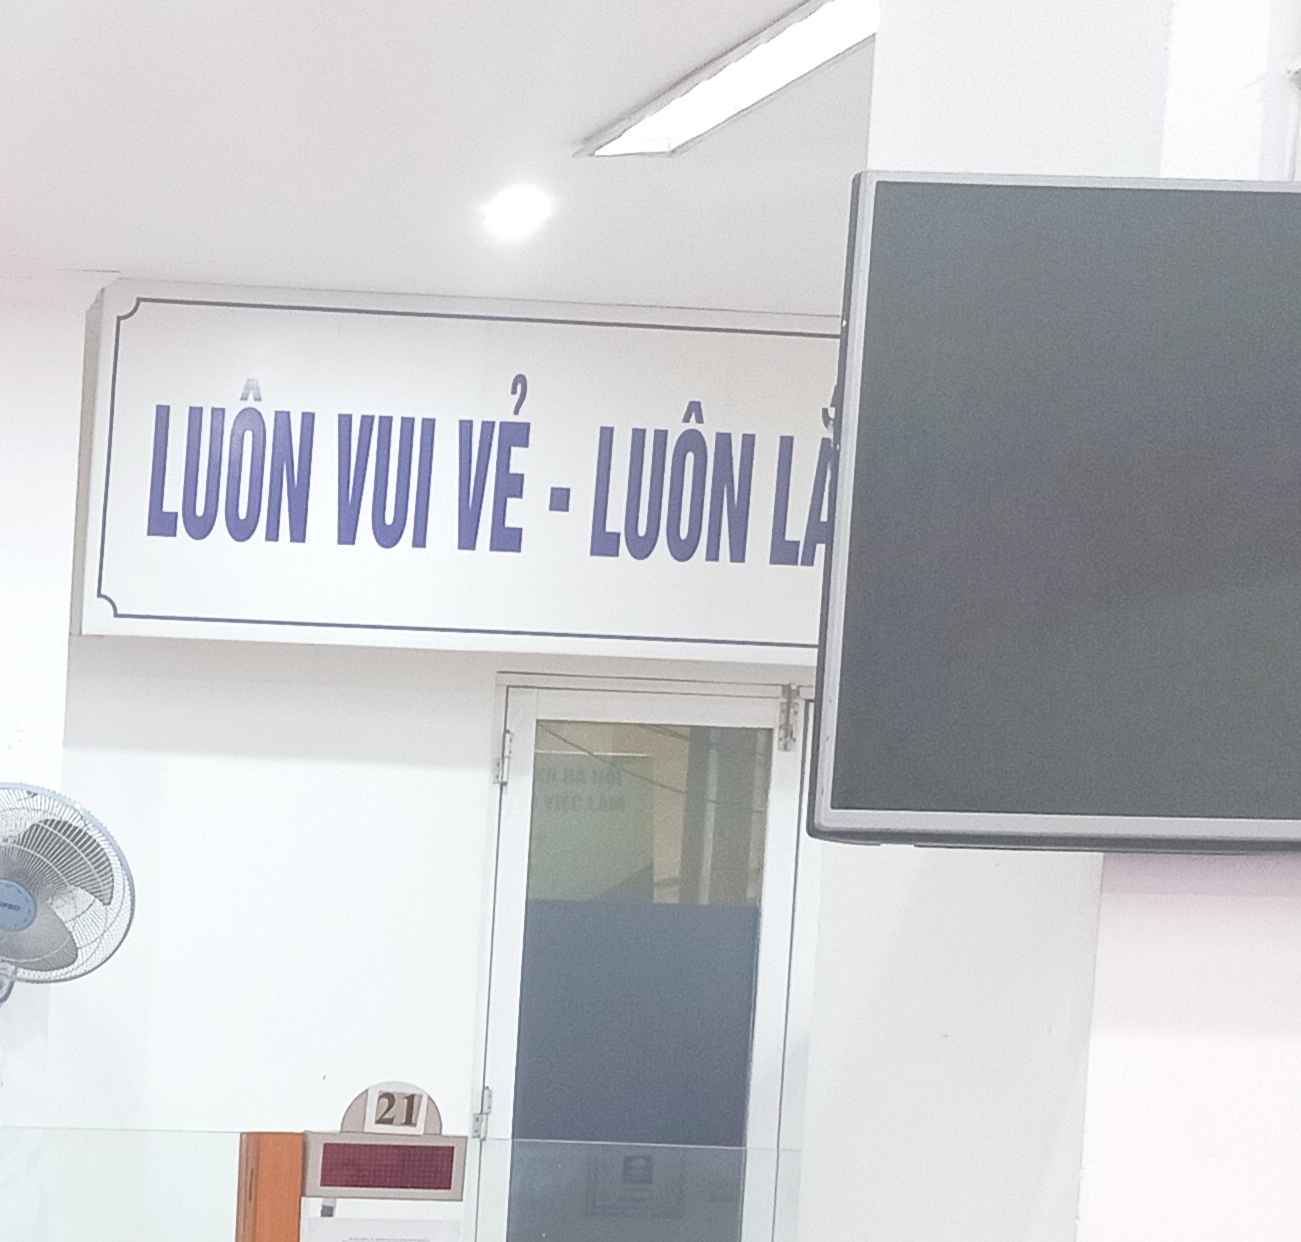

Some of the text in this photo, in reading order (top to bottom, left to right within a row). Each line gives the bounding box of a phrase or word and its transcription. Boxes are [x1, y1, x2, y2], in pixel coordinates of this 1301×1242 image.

[146, 377, 316, 544] LUÔN
[337, 412, 437, 549] VUI
[456, 373, 532, 554] VẺ
[589, 400, 756, 564] LUÔN
[374, 1091, 418, 1127] 21
